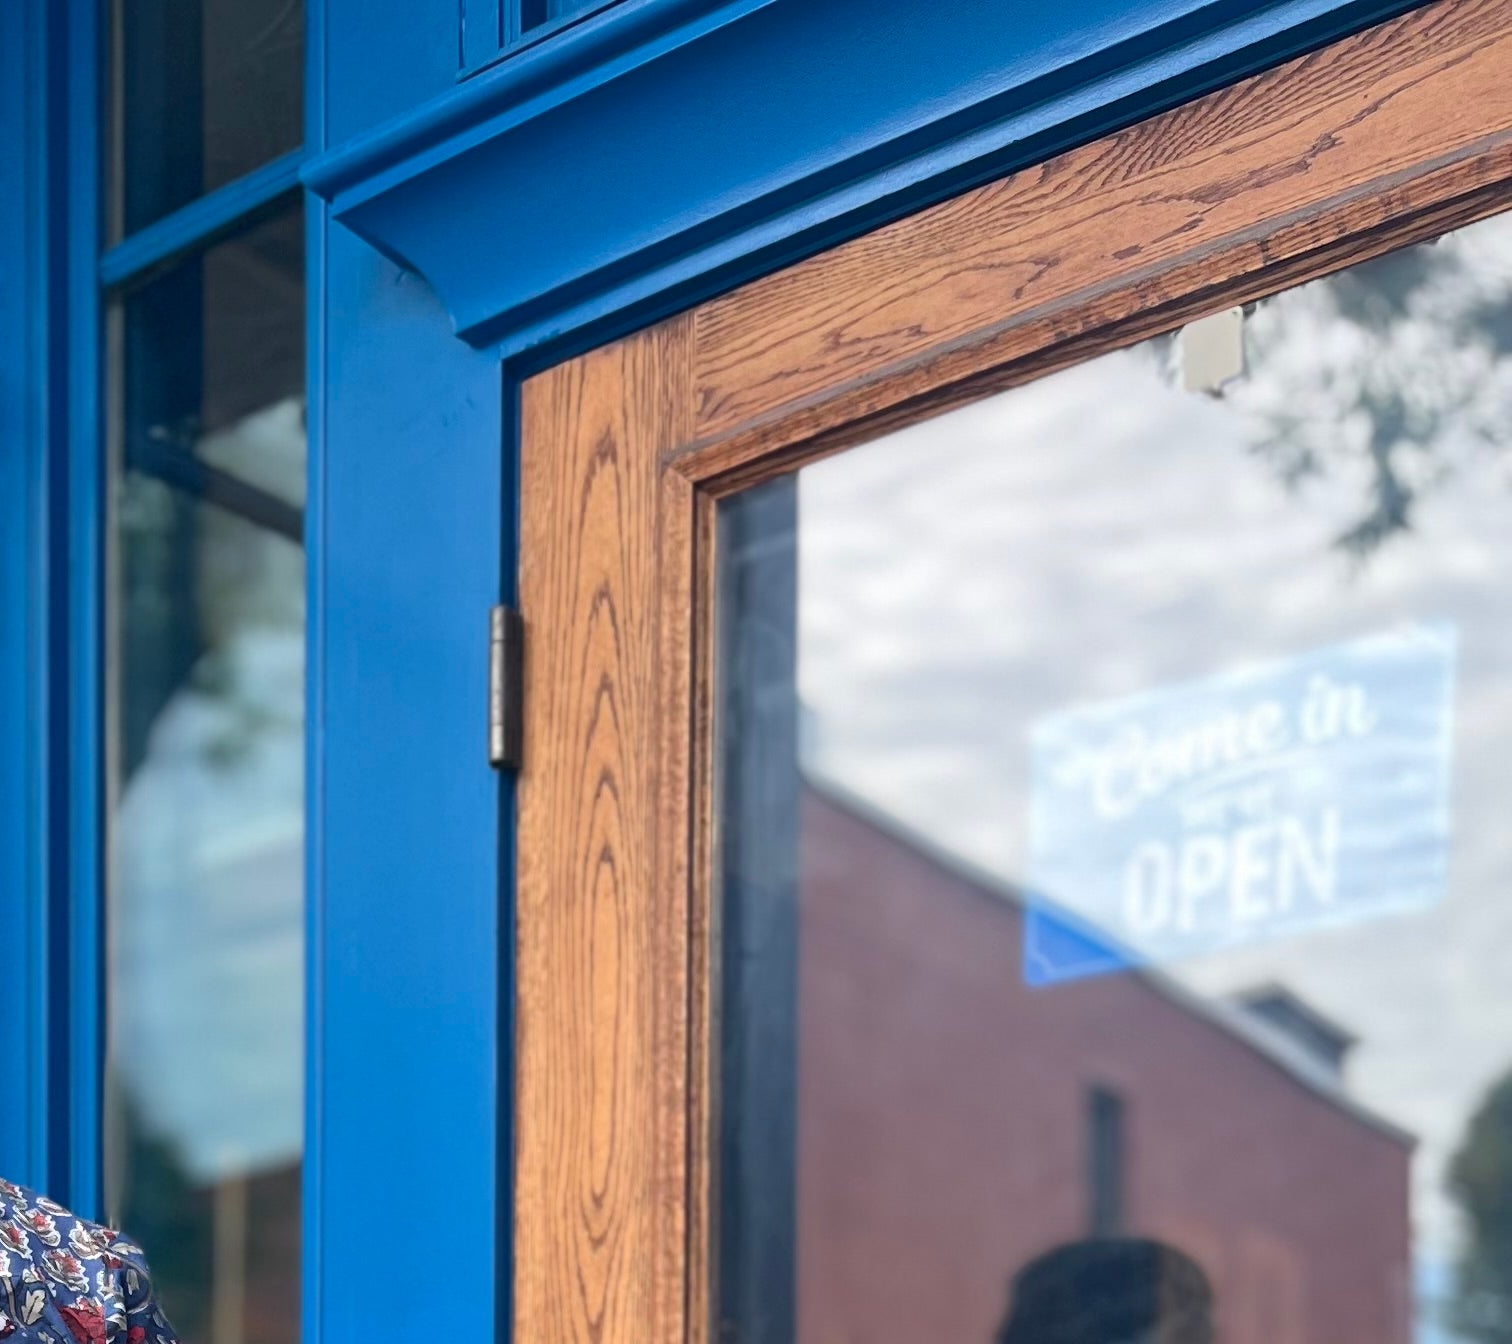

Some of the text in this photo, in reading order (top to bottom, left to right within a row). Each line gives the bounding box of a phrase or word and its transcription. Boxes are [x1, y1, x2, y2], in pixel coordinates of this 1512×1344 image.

[1058, 703, 1284, 818] Come
[1303, 674, 1377, 742] in
[1124, 806, 1340, 931] OPEN
